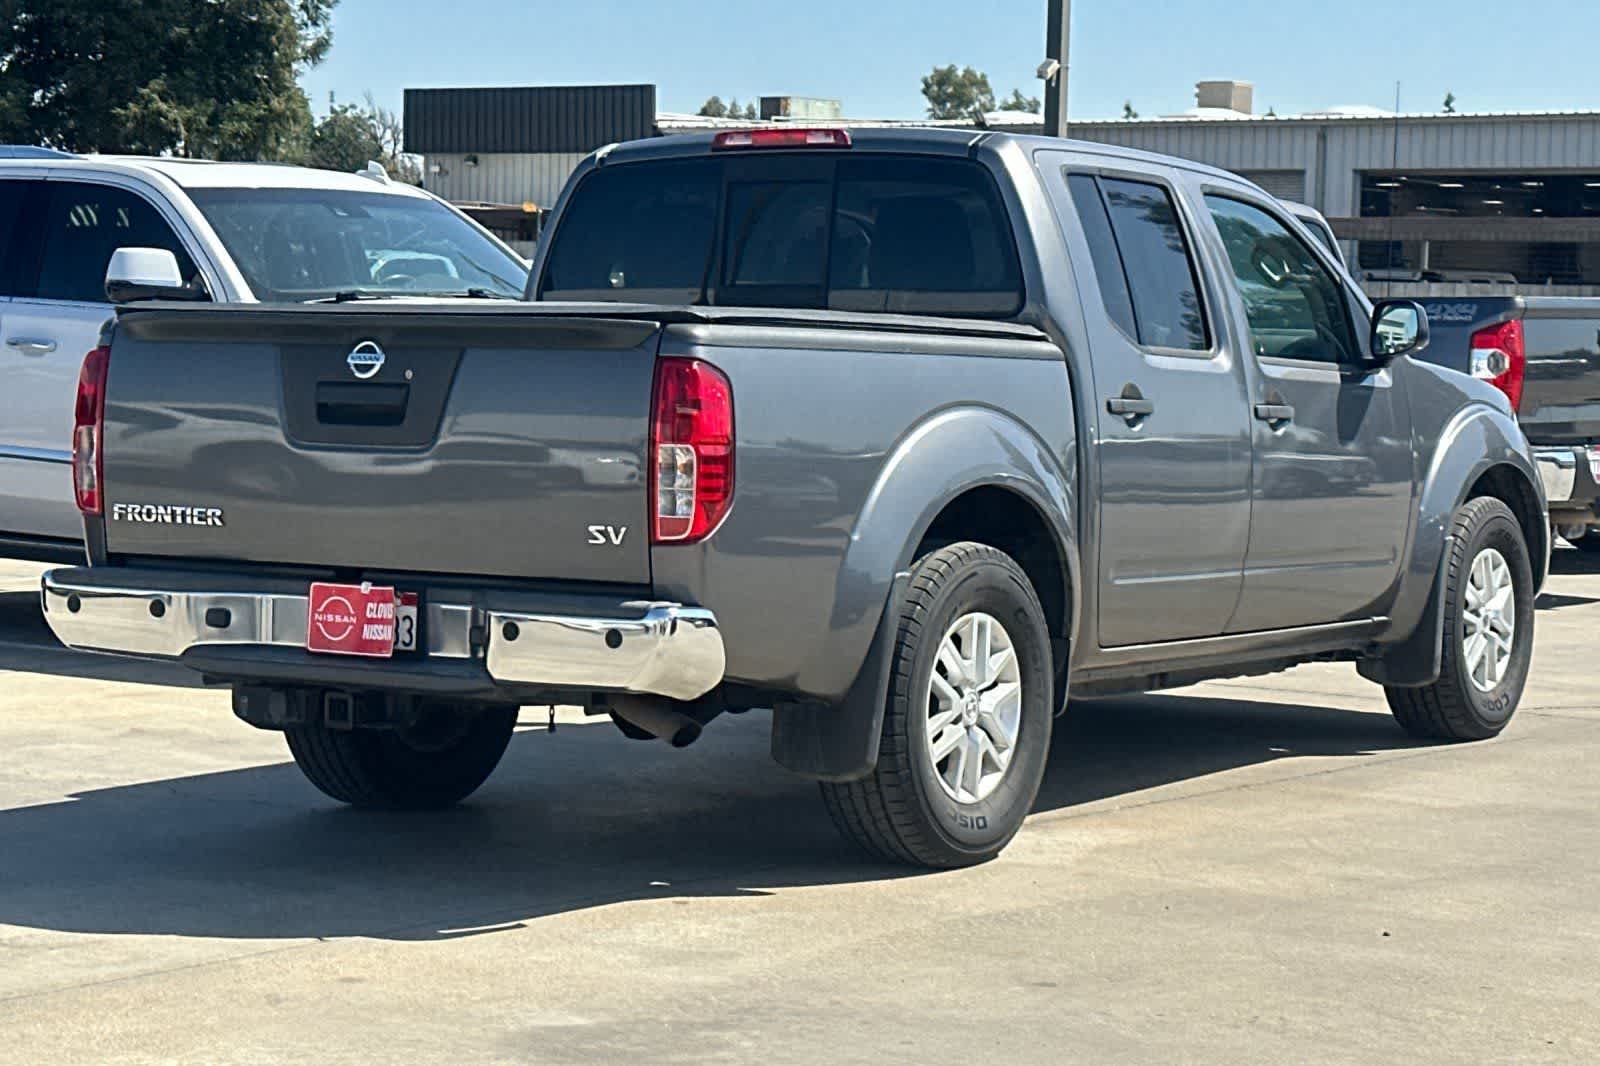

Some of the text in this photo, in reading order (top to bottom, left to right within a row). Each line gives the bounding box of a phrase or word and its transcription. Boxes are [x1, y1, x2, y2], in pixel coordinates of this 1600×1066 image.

[350, 354, 381, 362] NISSAN
[113, 503, 223, 526] FRONTIER
[588, 525, 627, 545] SV
[314, 613, 357, 625] NISSAN
[362, 623, 393, 641] NISSAN
